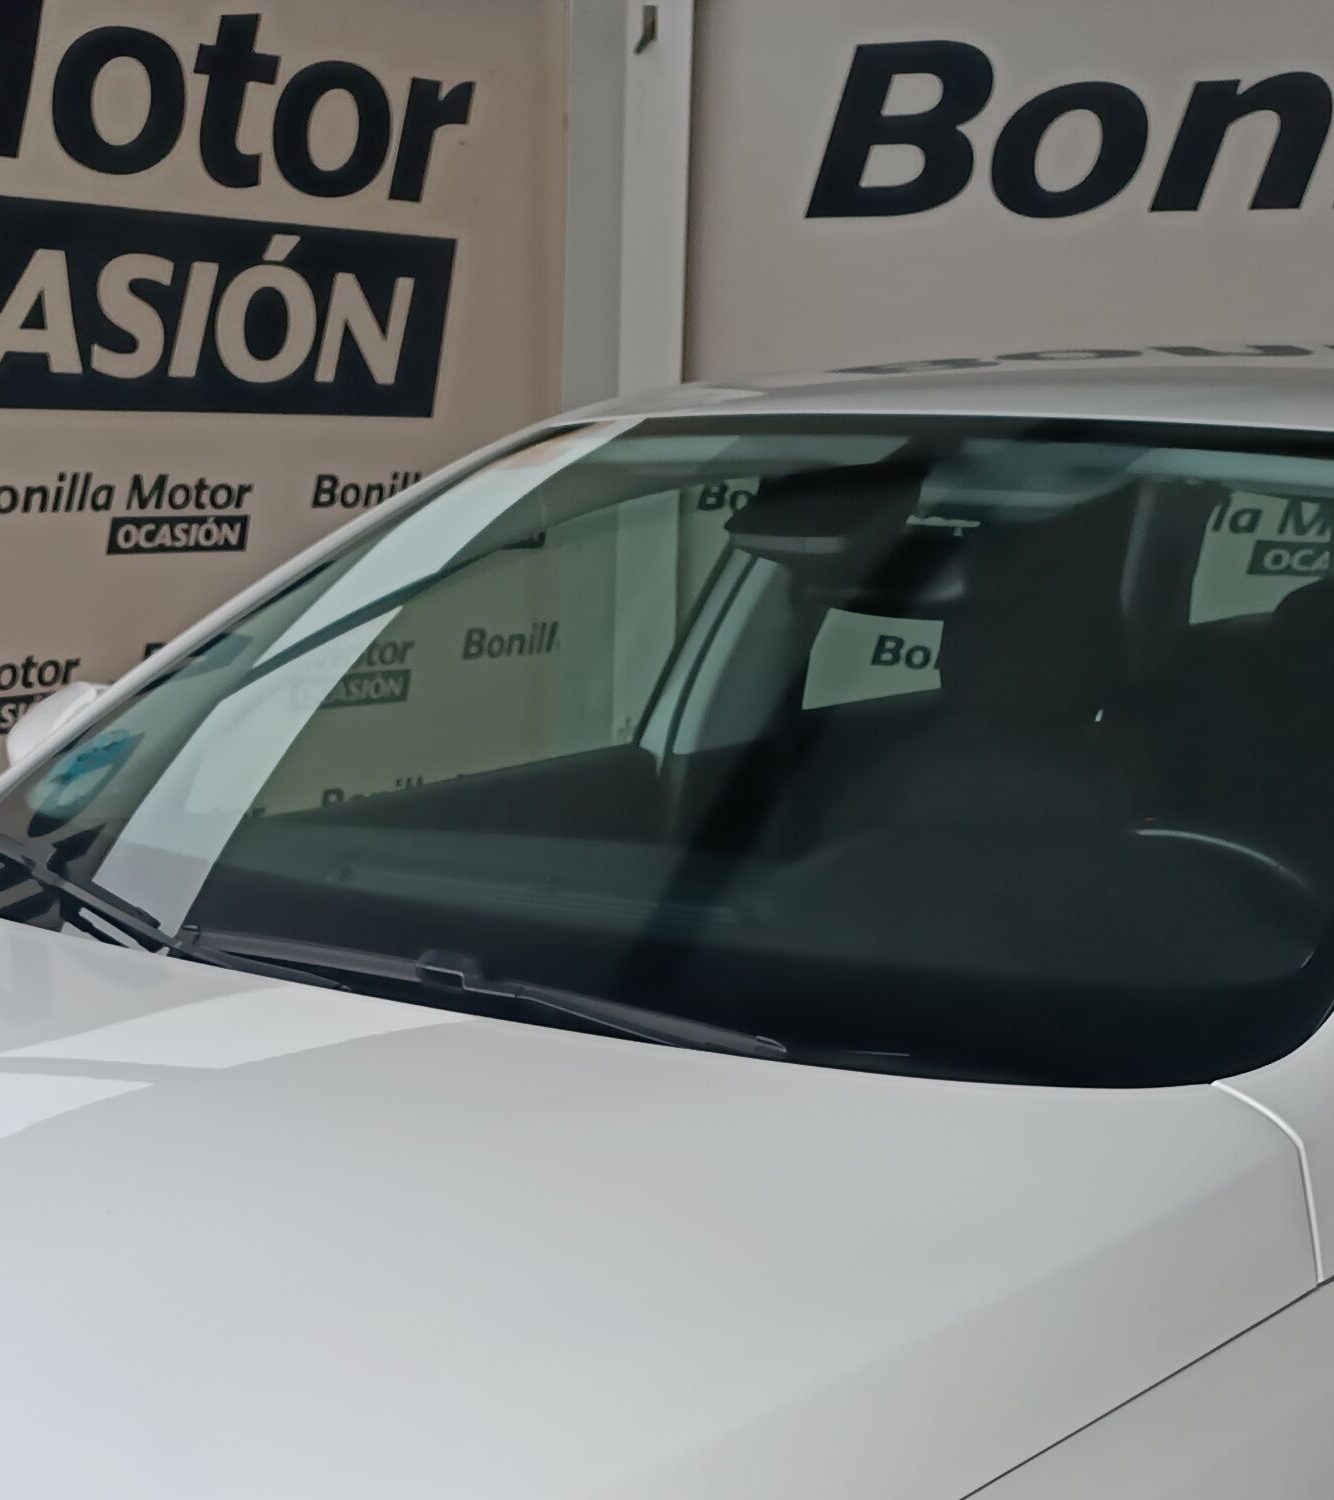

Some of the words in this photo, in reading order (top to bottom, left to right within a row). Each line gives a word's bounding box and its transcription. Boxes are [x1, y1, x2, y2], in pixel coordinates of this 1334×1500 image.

[125, 473, 253, 512] Motor
[116, 517, 242, 549] OCASIÓN
[461, 620, 559, 660] Bonill
